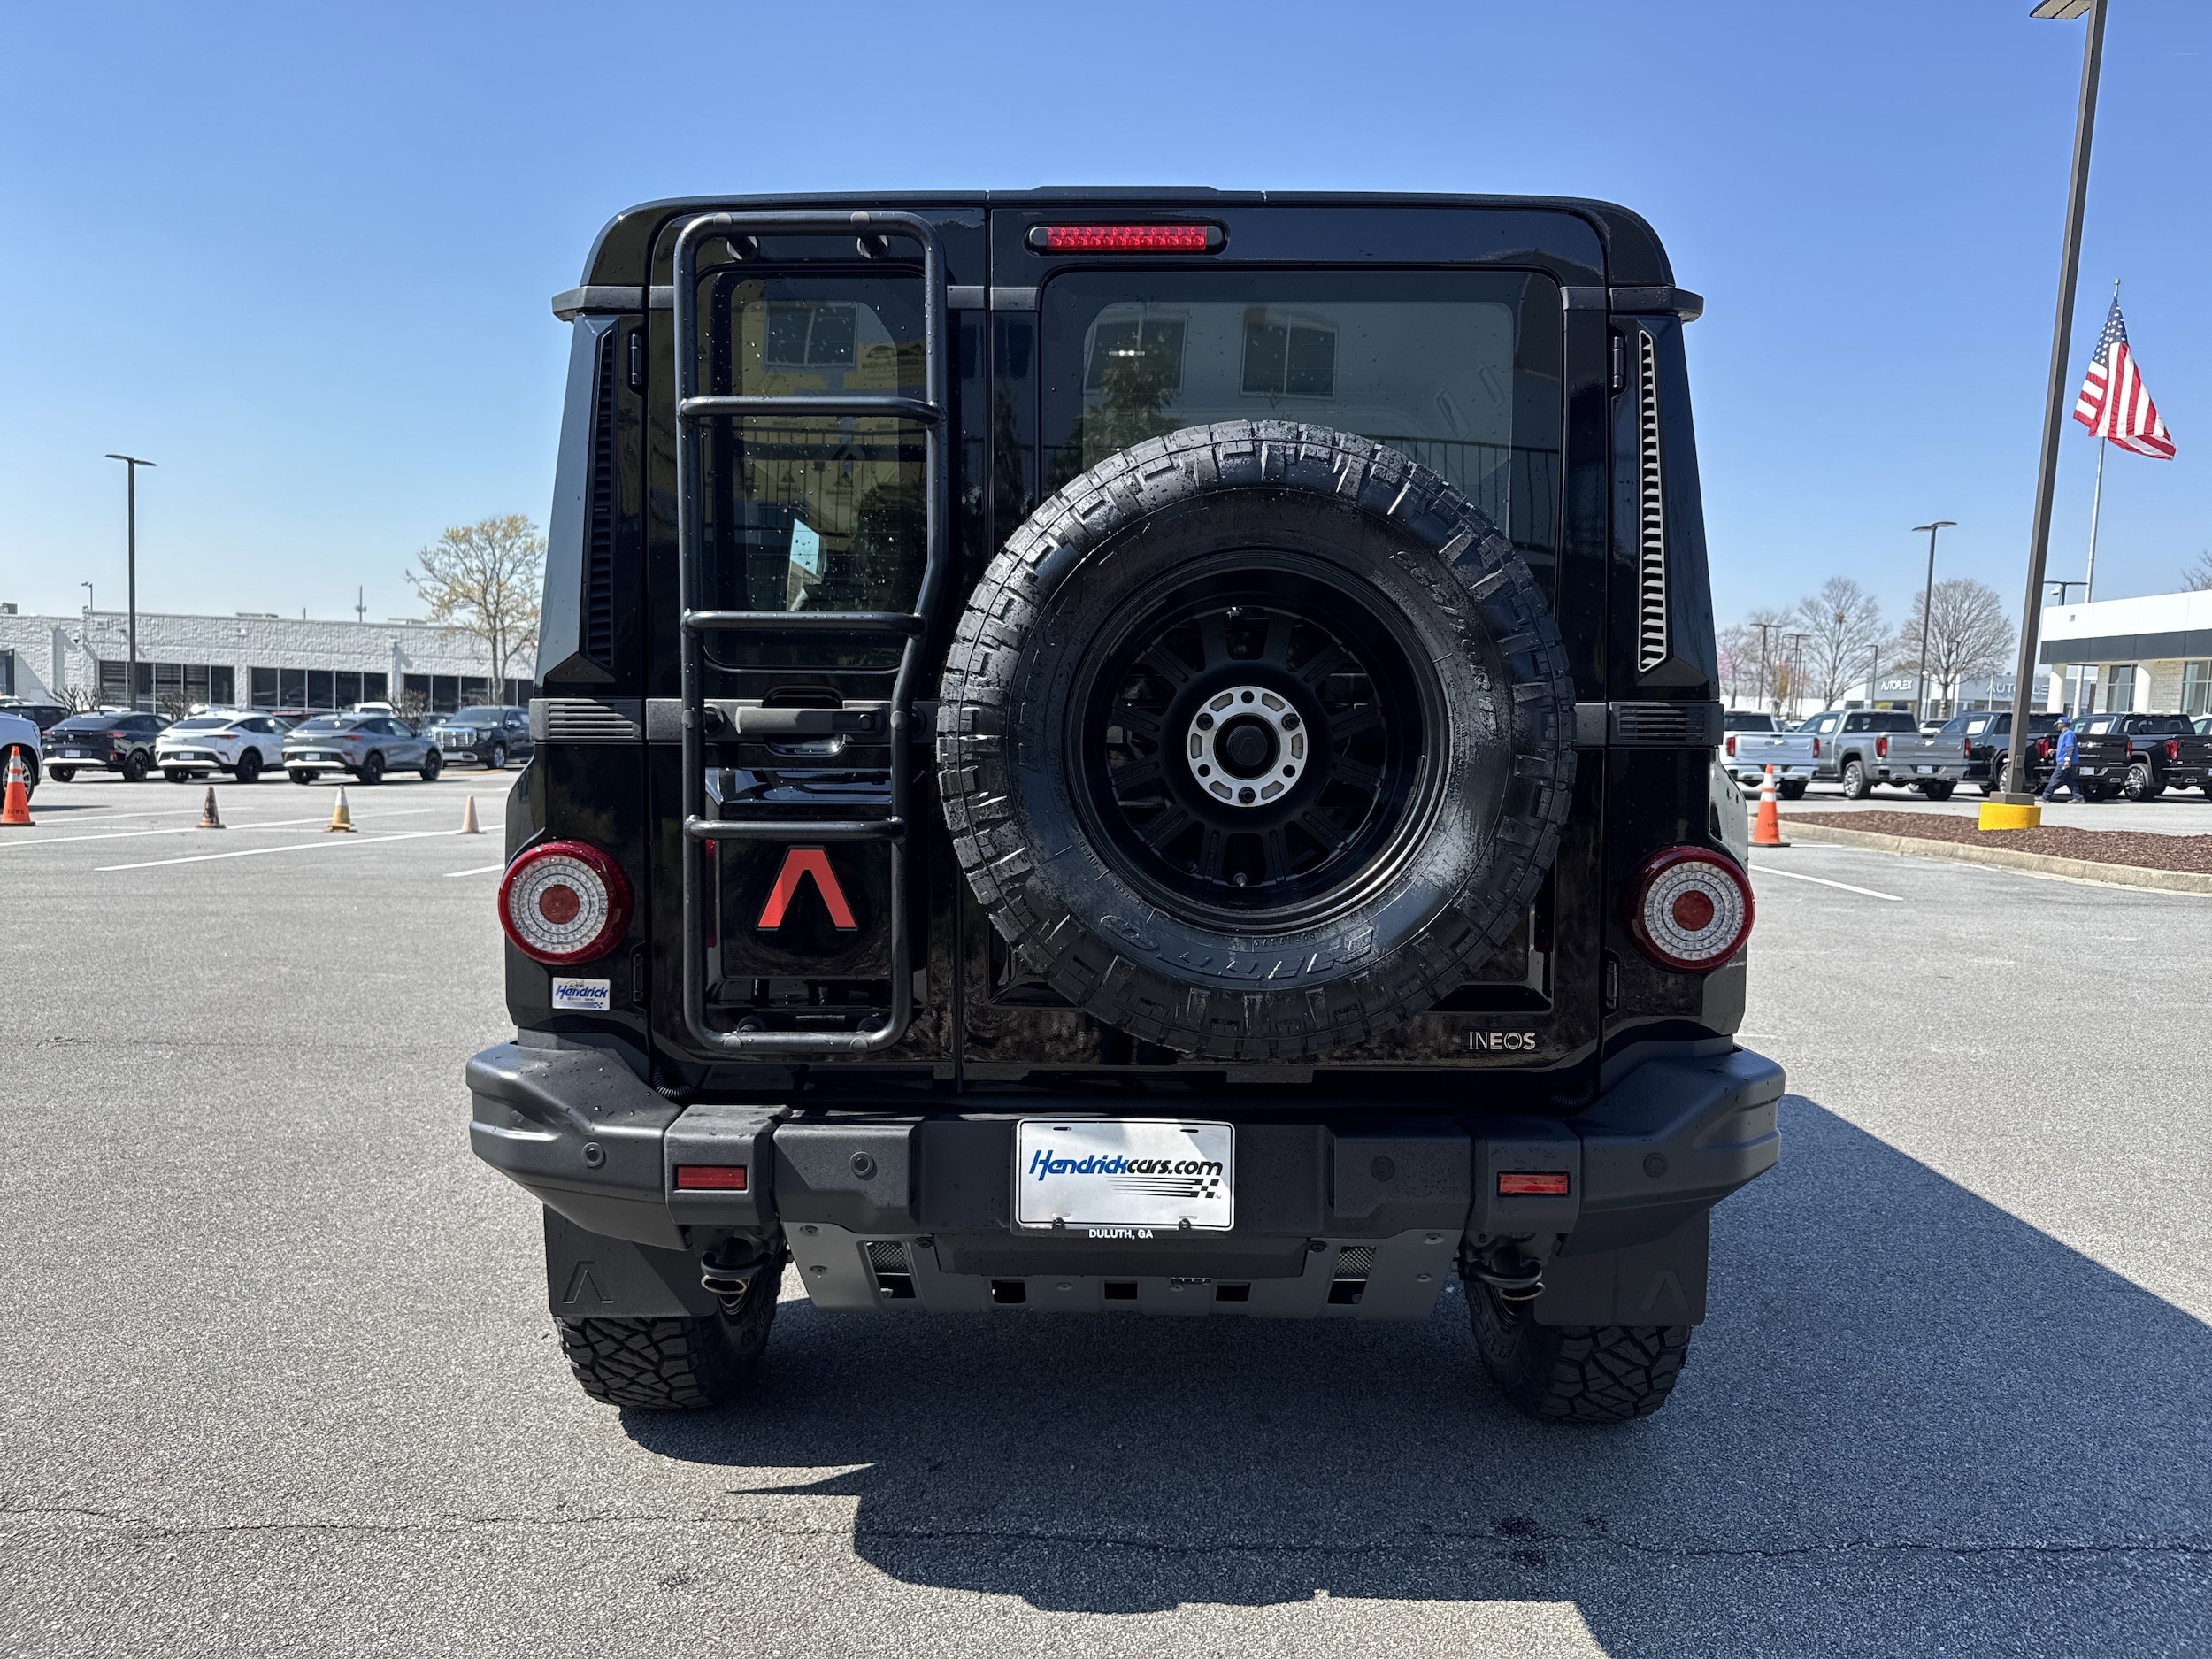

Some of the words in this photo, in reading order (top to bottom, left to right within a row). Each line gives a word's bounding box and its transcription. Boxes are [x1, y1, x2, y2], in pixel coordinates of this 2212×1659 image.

[1881, 680, 1913, 691] AUTOPLEX
[556, 985, 609, 1000] Hendrick
[1469, 1032, 1536, 1050] INEOS
[1029, 1150, 1224, 1180] Hendrickcars.com
[1089, 1228, 1135, 1240] DULUTH,
[1138, 1229, 1154, 1239] GA
